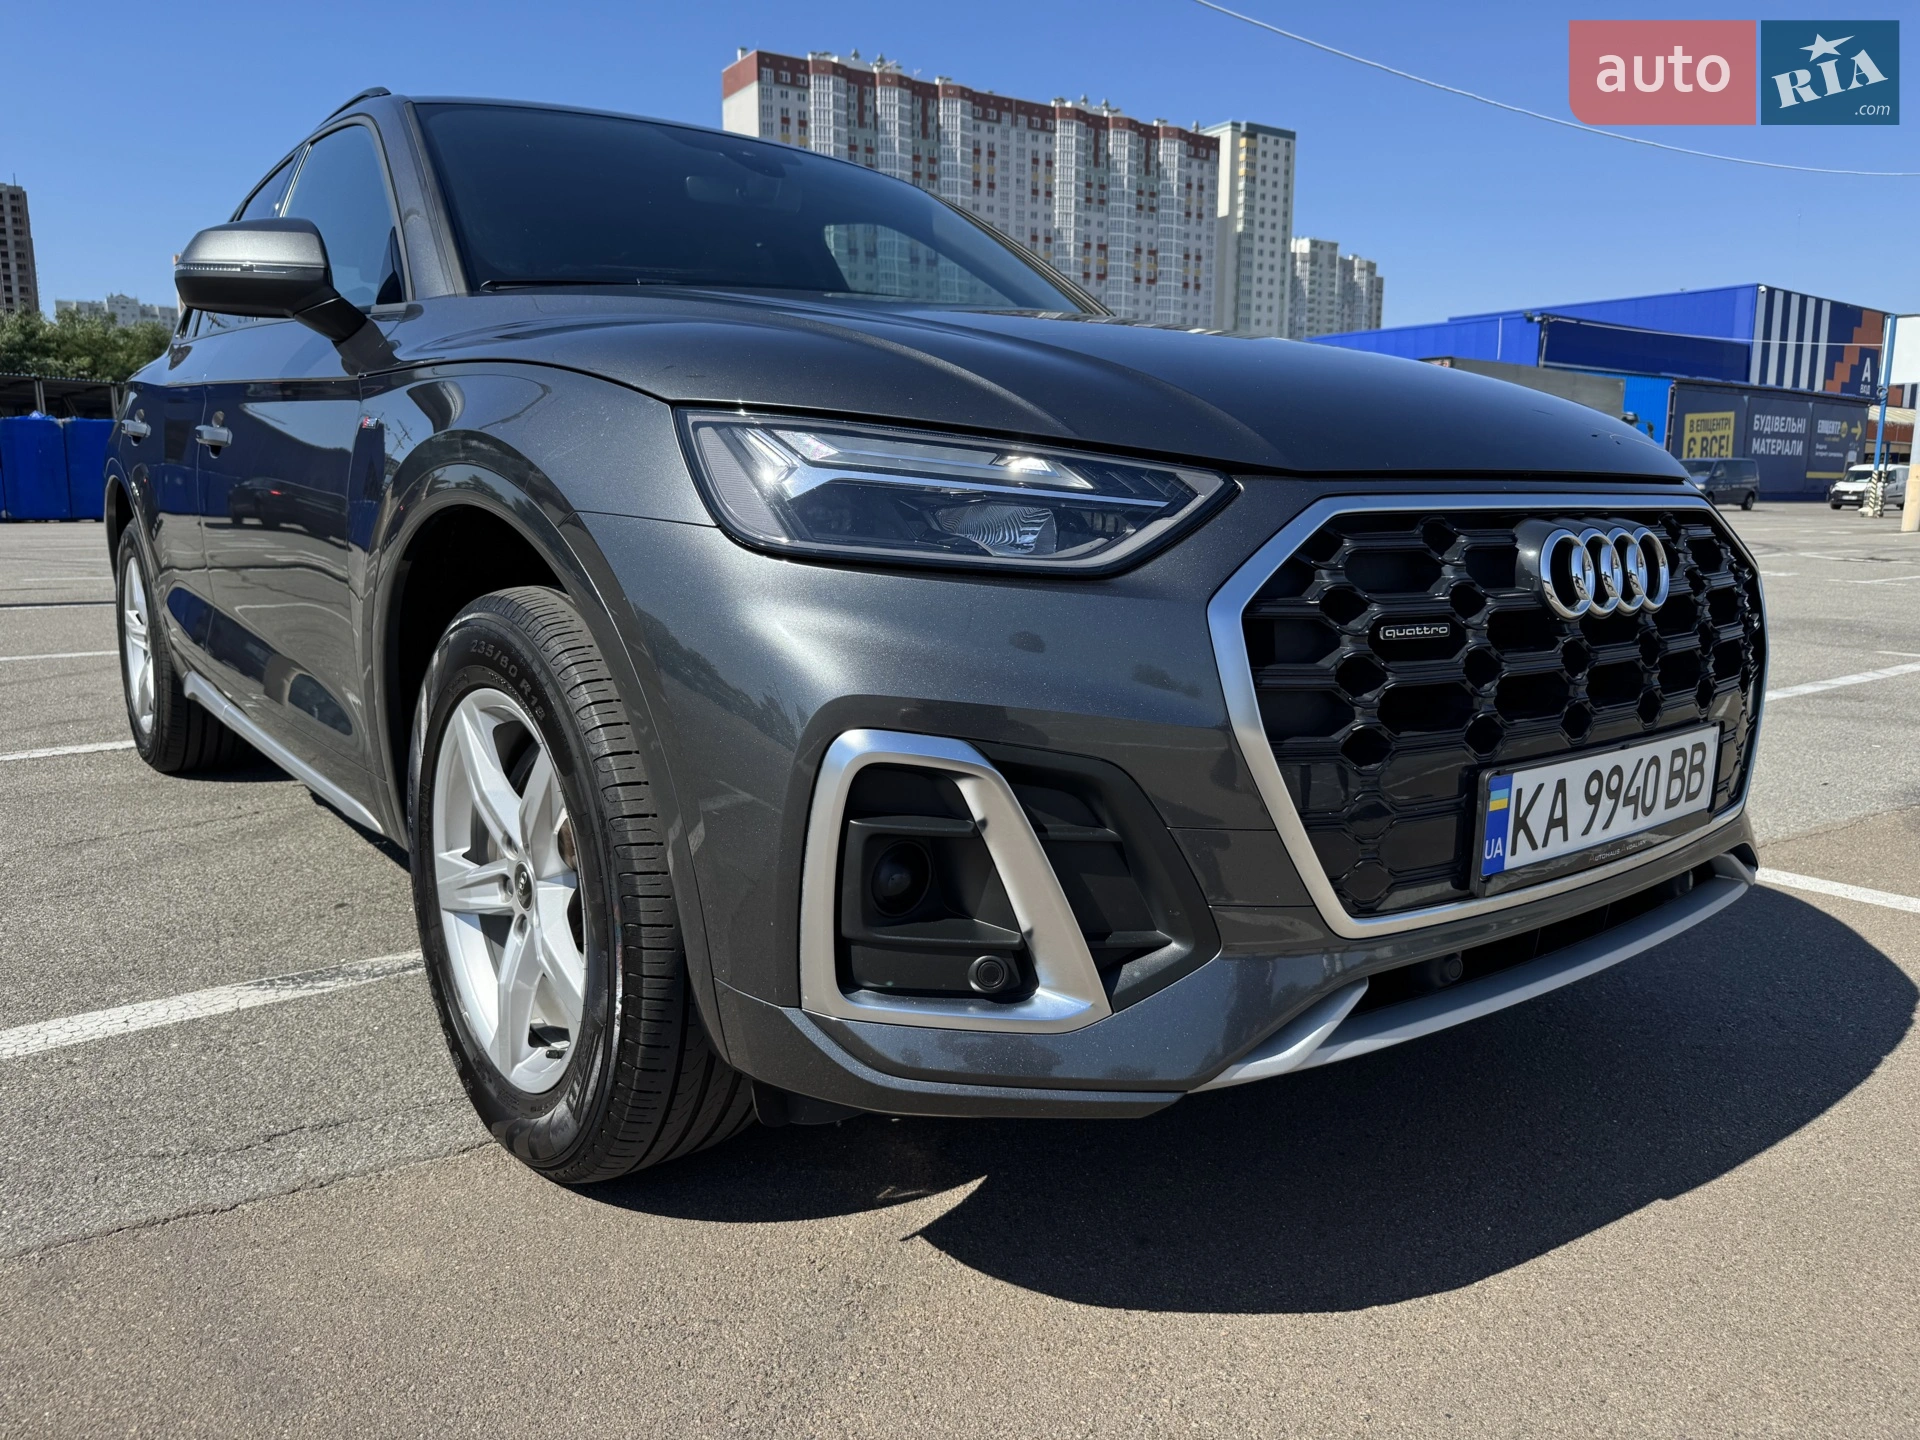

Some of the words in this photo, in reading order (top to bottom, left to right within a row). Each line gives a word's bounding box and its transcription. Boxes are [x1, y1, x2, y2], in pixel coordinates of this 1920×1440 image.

[1689, 419, 1695, 433] В
[1753, 414, 1806, 434] БУДІВЕЛЬНІ
[1687, 436, 1696, 458] Є
[1700, 434, 1730, 458] ВСЕ!
[1751, 437, 1803, 456] МАТЕРІАЛИ
[1385, 626, 1448, 638] quattro
[1510, 778, 1569, 856] KA
[1581, 755, 1661, 836] 9940
[1664, 742, 1707, 810] BB
[1484, 837, 1504, 860] UA
